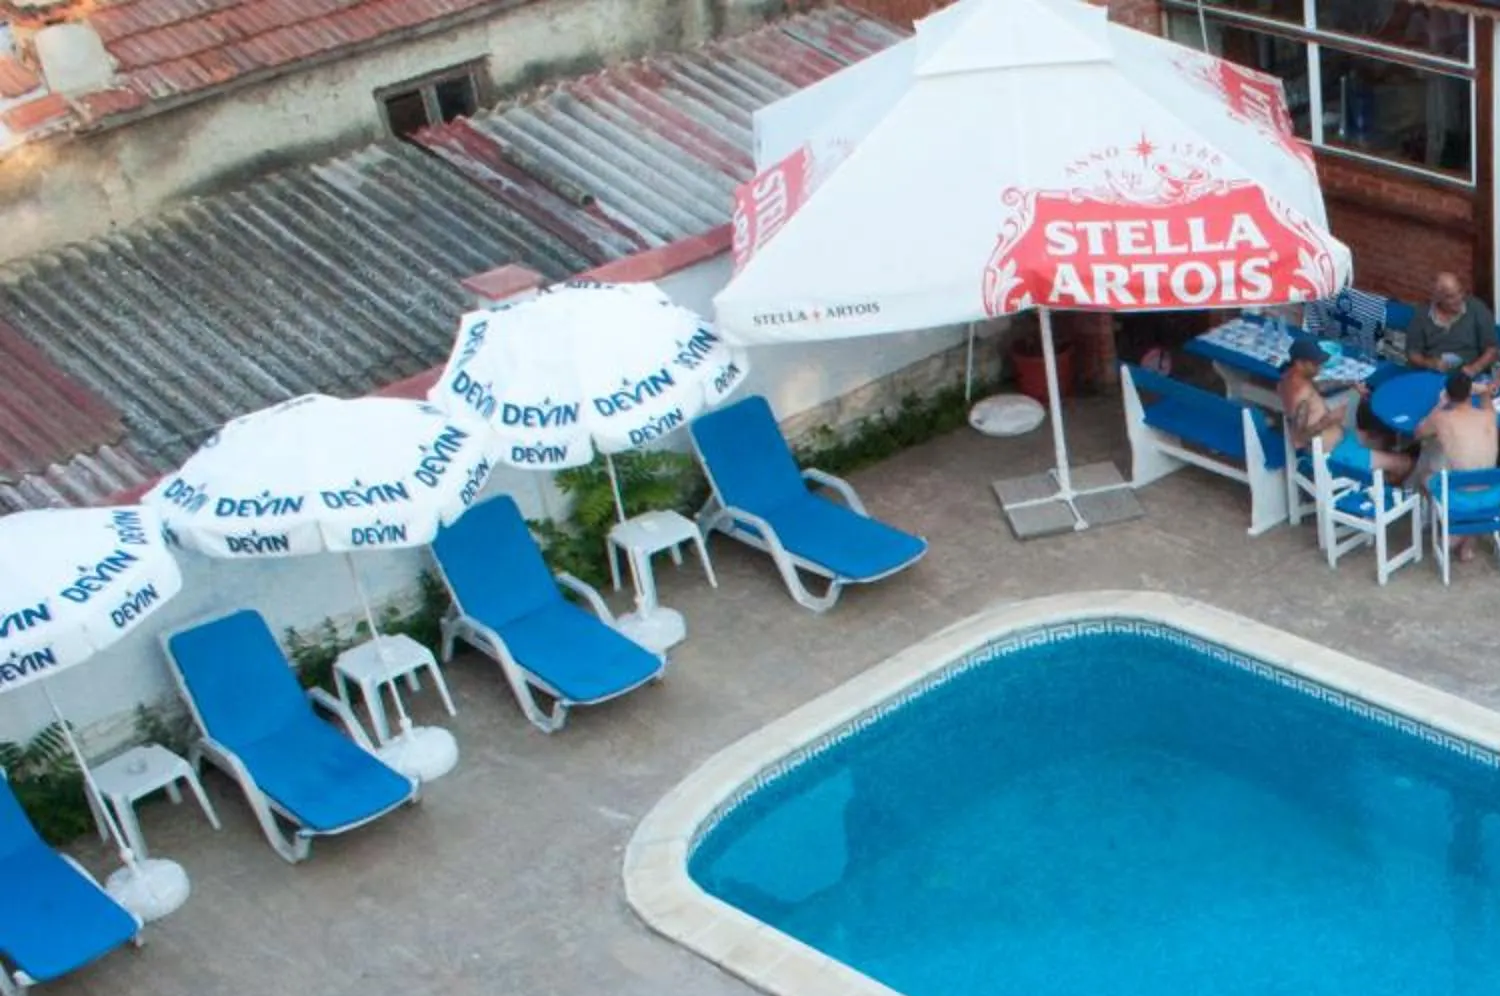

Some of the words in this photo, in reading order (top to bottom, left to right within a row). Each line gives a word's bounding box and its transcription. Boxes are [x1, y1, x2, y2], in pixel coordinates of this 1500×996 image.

[1044, 213, 1269, 256] STELLA
[1048, 255, 1273, 304] ARTOIS
[753, 311, 808, 326] STELLA
[826, 302, 881, 318] ARTOIS
[593, 367, 676, 417] DEVIN
[502, 402, 579, 425] DEVIN
[630, 408, 683, 446] DEVIN
[414, 425, 468, 488] DEVIN
[512, 445, 567, 463] DEVIN
[320, 481, 410, 509] DEVIN
[460, 458, 490, 505] DEVIN
[215, 495, 304, 517] DEVIN
[226, 533, 290, 554] DEVIN
[352, 524, 407, 546] DEVIN
[61, 549, 138, 603] DEVIN
[0, 603, 51, 638] VIN
[109, 583, 160, 629] DEVIN
